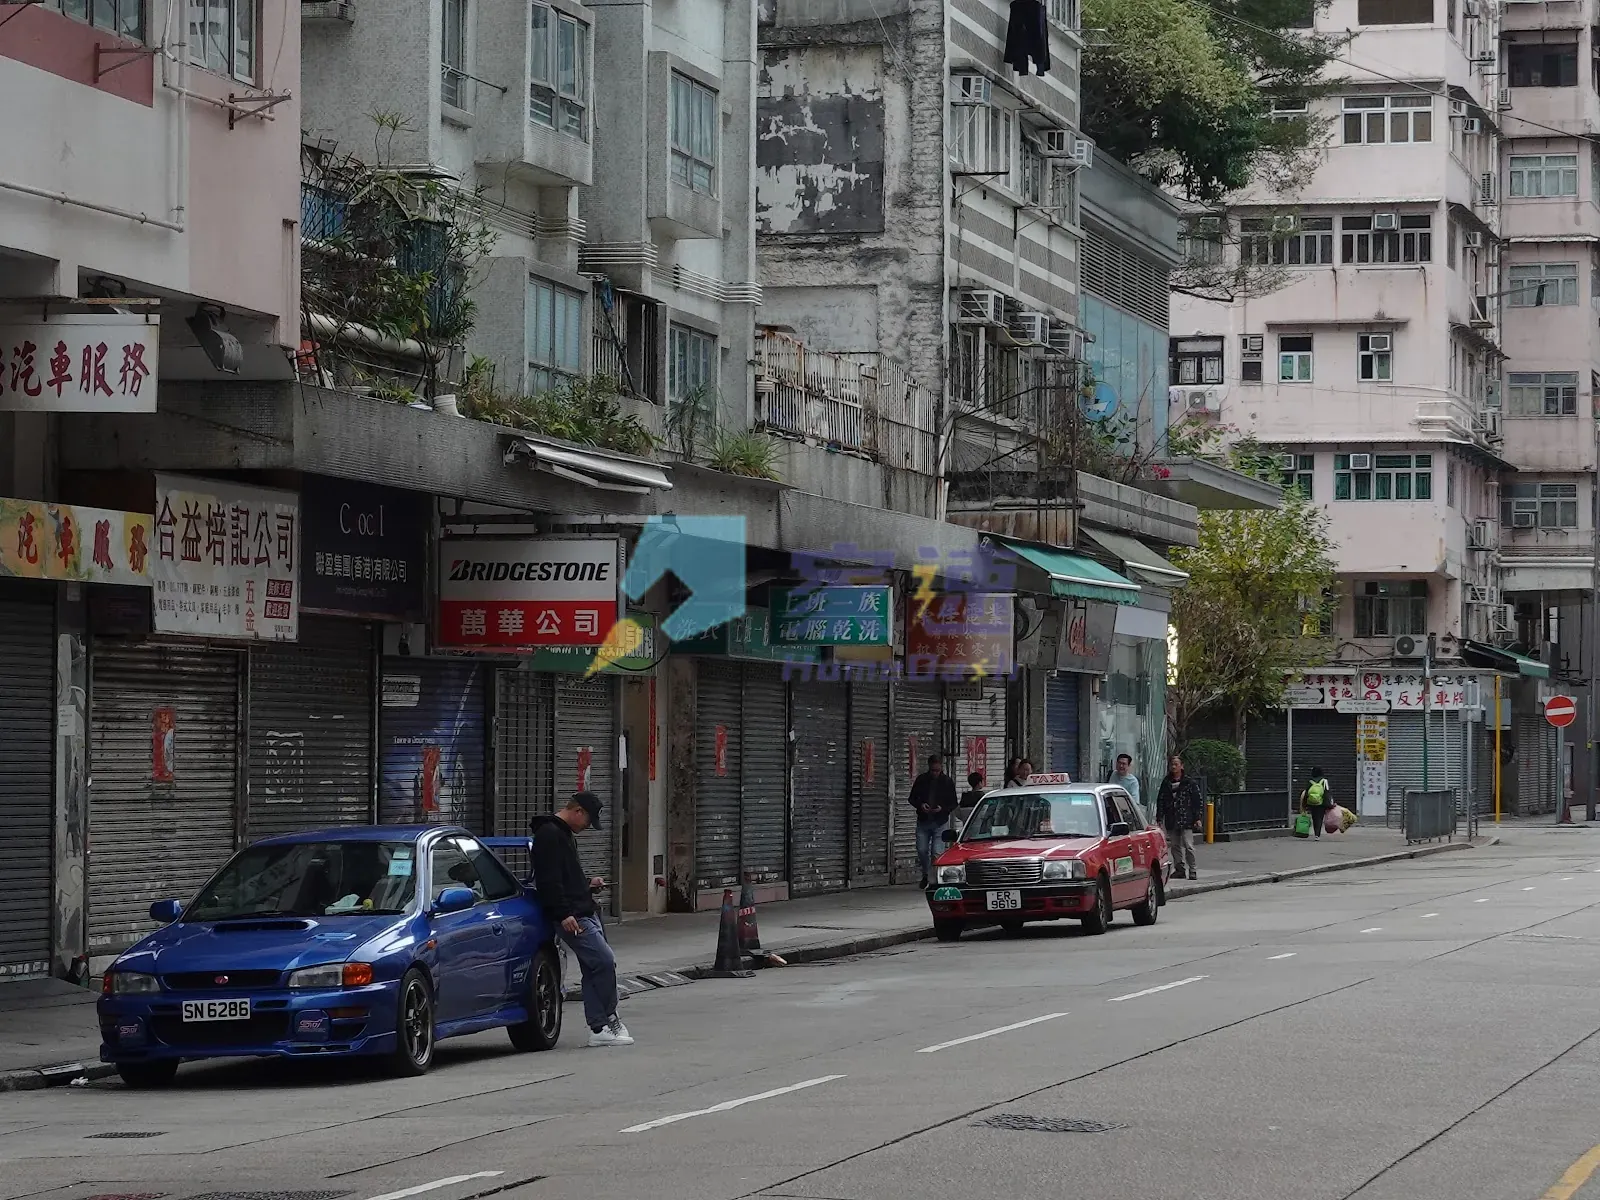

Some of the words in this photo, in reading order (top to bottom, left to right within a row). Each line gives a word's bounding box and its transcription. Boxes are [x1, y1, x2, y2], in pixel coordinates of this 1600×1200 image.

[0, 340, 150, 398] 汽車服務
[449, 559, 610, 581] BRIDGESTONE
[460, 608, 599, 636] 萬華公司
[779, 619, 880, 642] 電腦乾洗
[1030, 774, 1065, 784] TAXI
[991, 900, 1017, 909] 9619
[996, 891, 1011, 900] ER
[184, 1003, 204, 1020] SN
[207, 1000, 249, 1018] 6286
